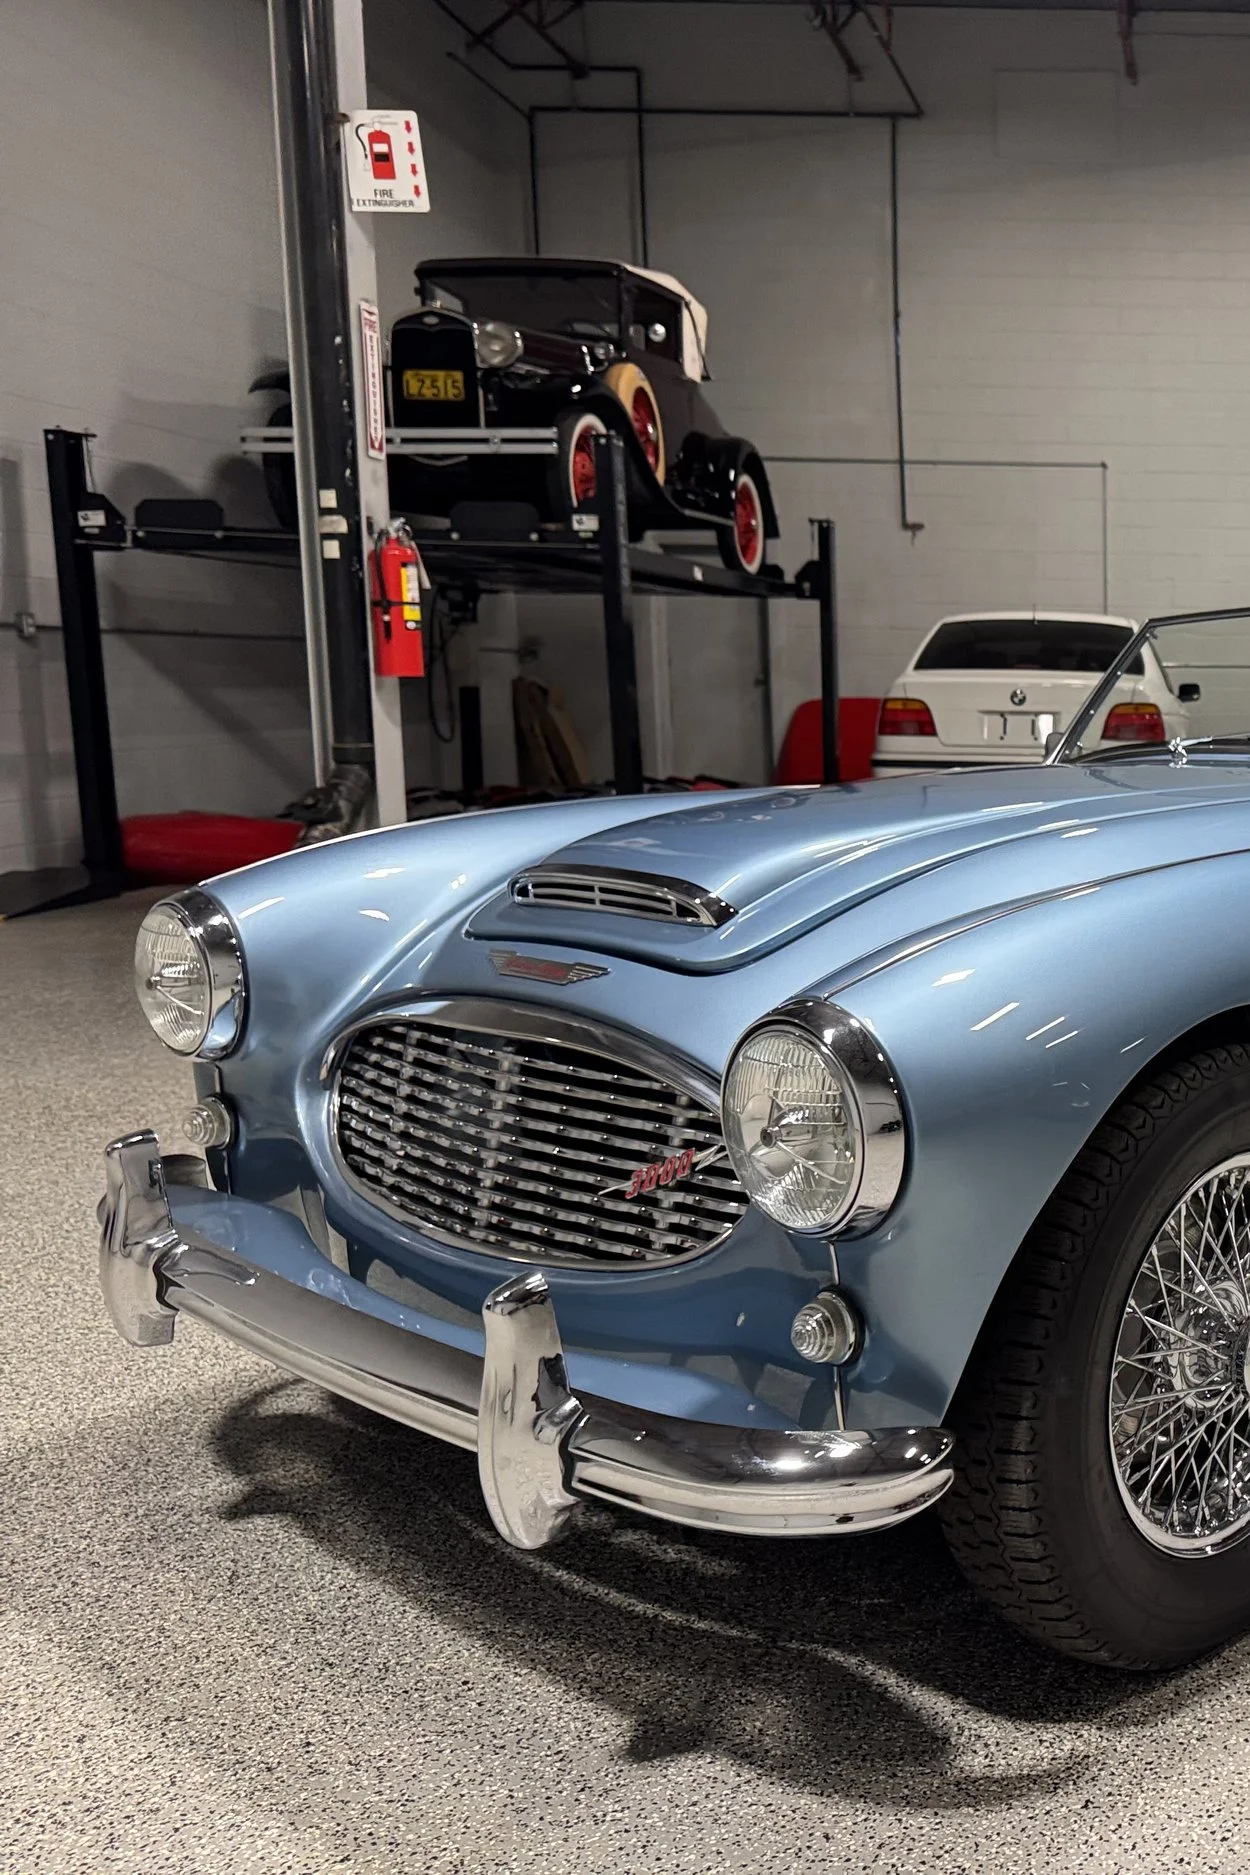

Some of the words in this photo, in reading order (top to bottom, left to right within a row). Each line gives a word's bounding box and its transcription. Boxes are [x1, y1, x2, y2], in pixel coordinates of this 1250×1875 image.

[374, 188, 394, 199] FIRE
[356, 199, 415, 208] EXTINGUISHER
[625, 1148, 695, 1199] 3000
